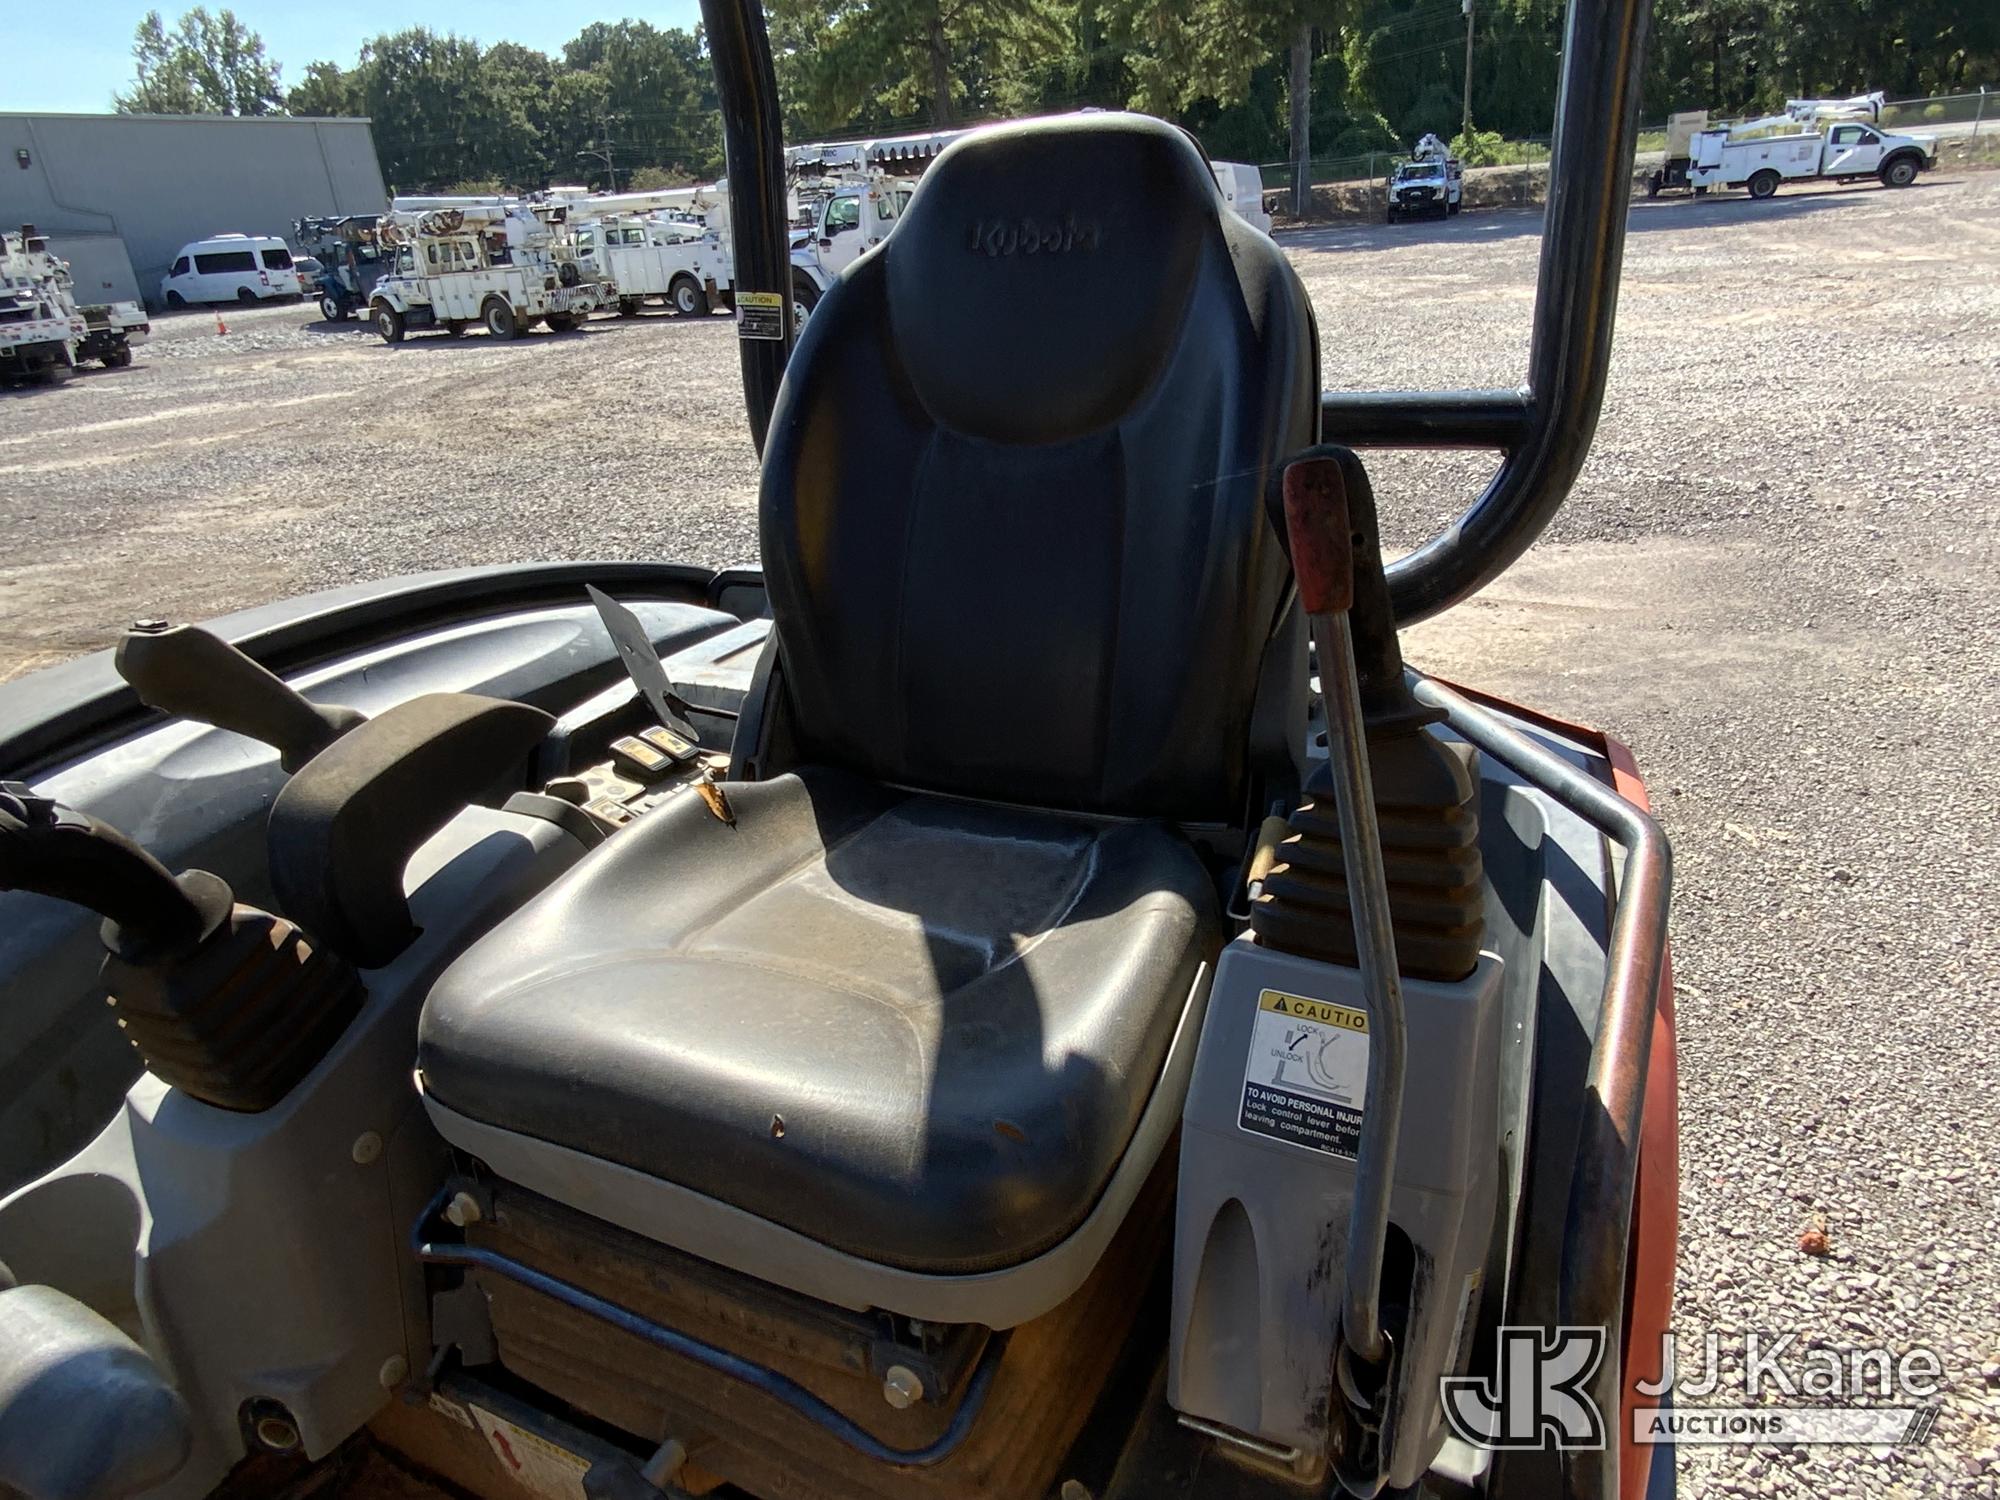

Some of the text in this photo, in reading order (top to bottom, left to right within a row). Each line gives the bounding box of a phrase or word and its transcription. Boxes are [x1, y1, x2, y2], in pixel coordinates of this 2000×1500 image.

[740, 295, 773, 305] CAUTION
[1296, 1023, 1319, 1035] LOCK
[1270, 1048, 1304, 1063] UNLOCK
[1247, 1087, 1259, 1098] TO
[1259, 1090, 1287, 1106] AVOID
[1287, 1097, 1335, 1119] PERSONAL
[1246, 1100, 1267, 1112] Lock
[1271, 1106, 1302, 1122] control
[1306, 1115, 1330, 1129] lever
[1244, 1111, 1342, 1144] leaving compartment.
